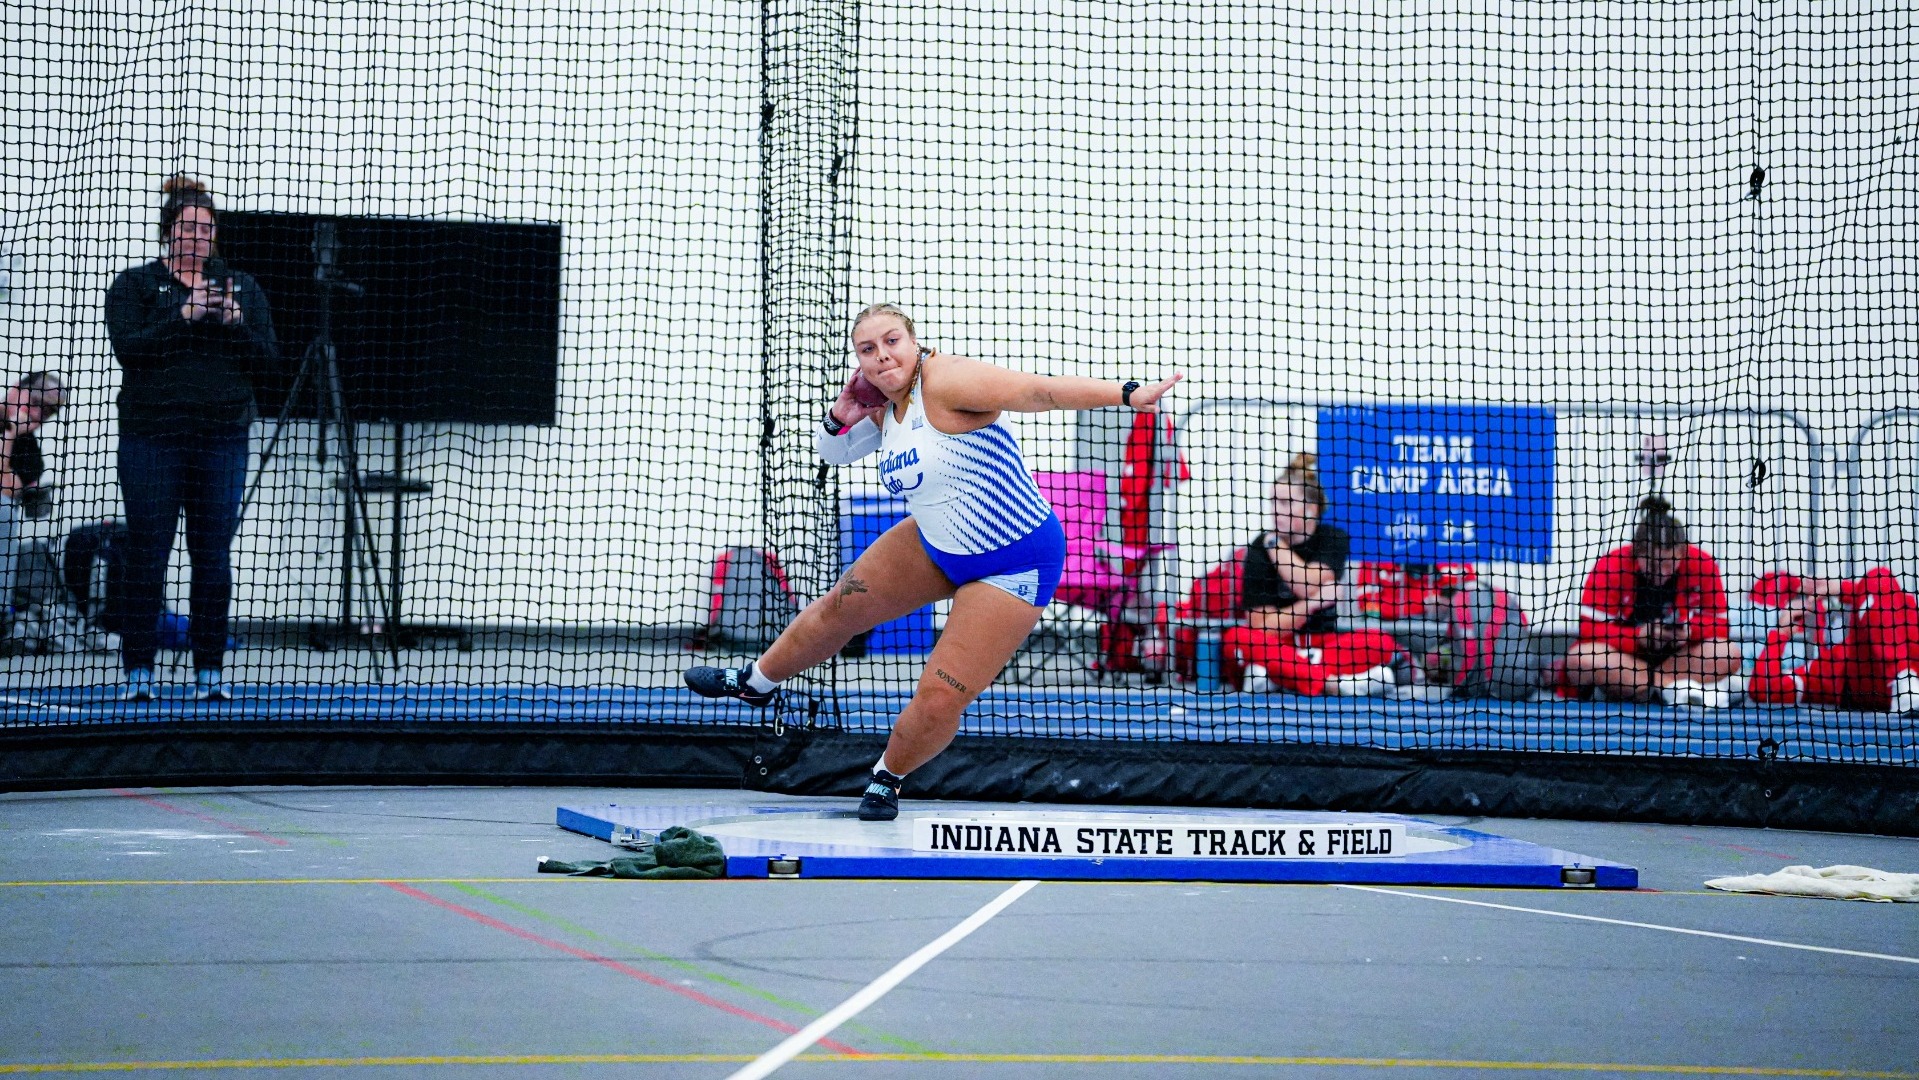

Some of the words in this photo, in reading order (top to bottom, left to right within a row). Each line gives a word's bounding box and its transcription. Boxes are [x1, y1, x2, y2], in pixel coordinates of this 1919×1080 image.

[879, 447, 920, 475] ndiana
[1393, 435, 1474, 462] TEAM
[1352, 465, 1428, 494] CAMP
[1437, 467, 1513, 496] AREA
[935, 668, 967, 693] SONDER
[866, 783, 890, 797] NIKE
[931, 824, 1062, 853] INDIANA
[1077, 828, 1173, 855] STATE
[1187, 829, 1286, 856] TRACK
[1298, 830, 1315, 855] &
[1327, 828, 1392, 855] FIELD
